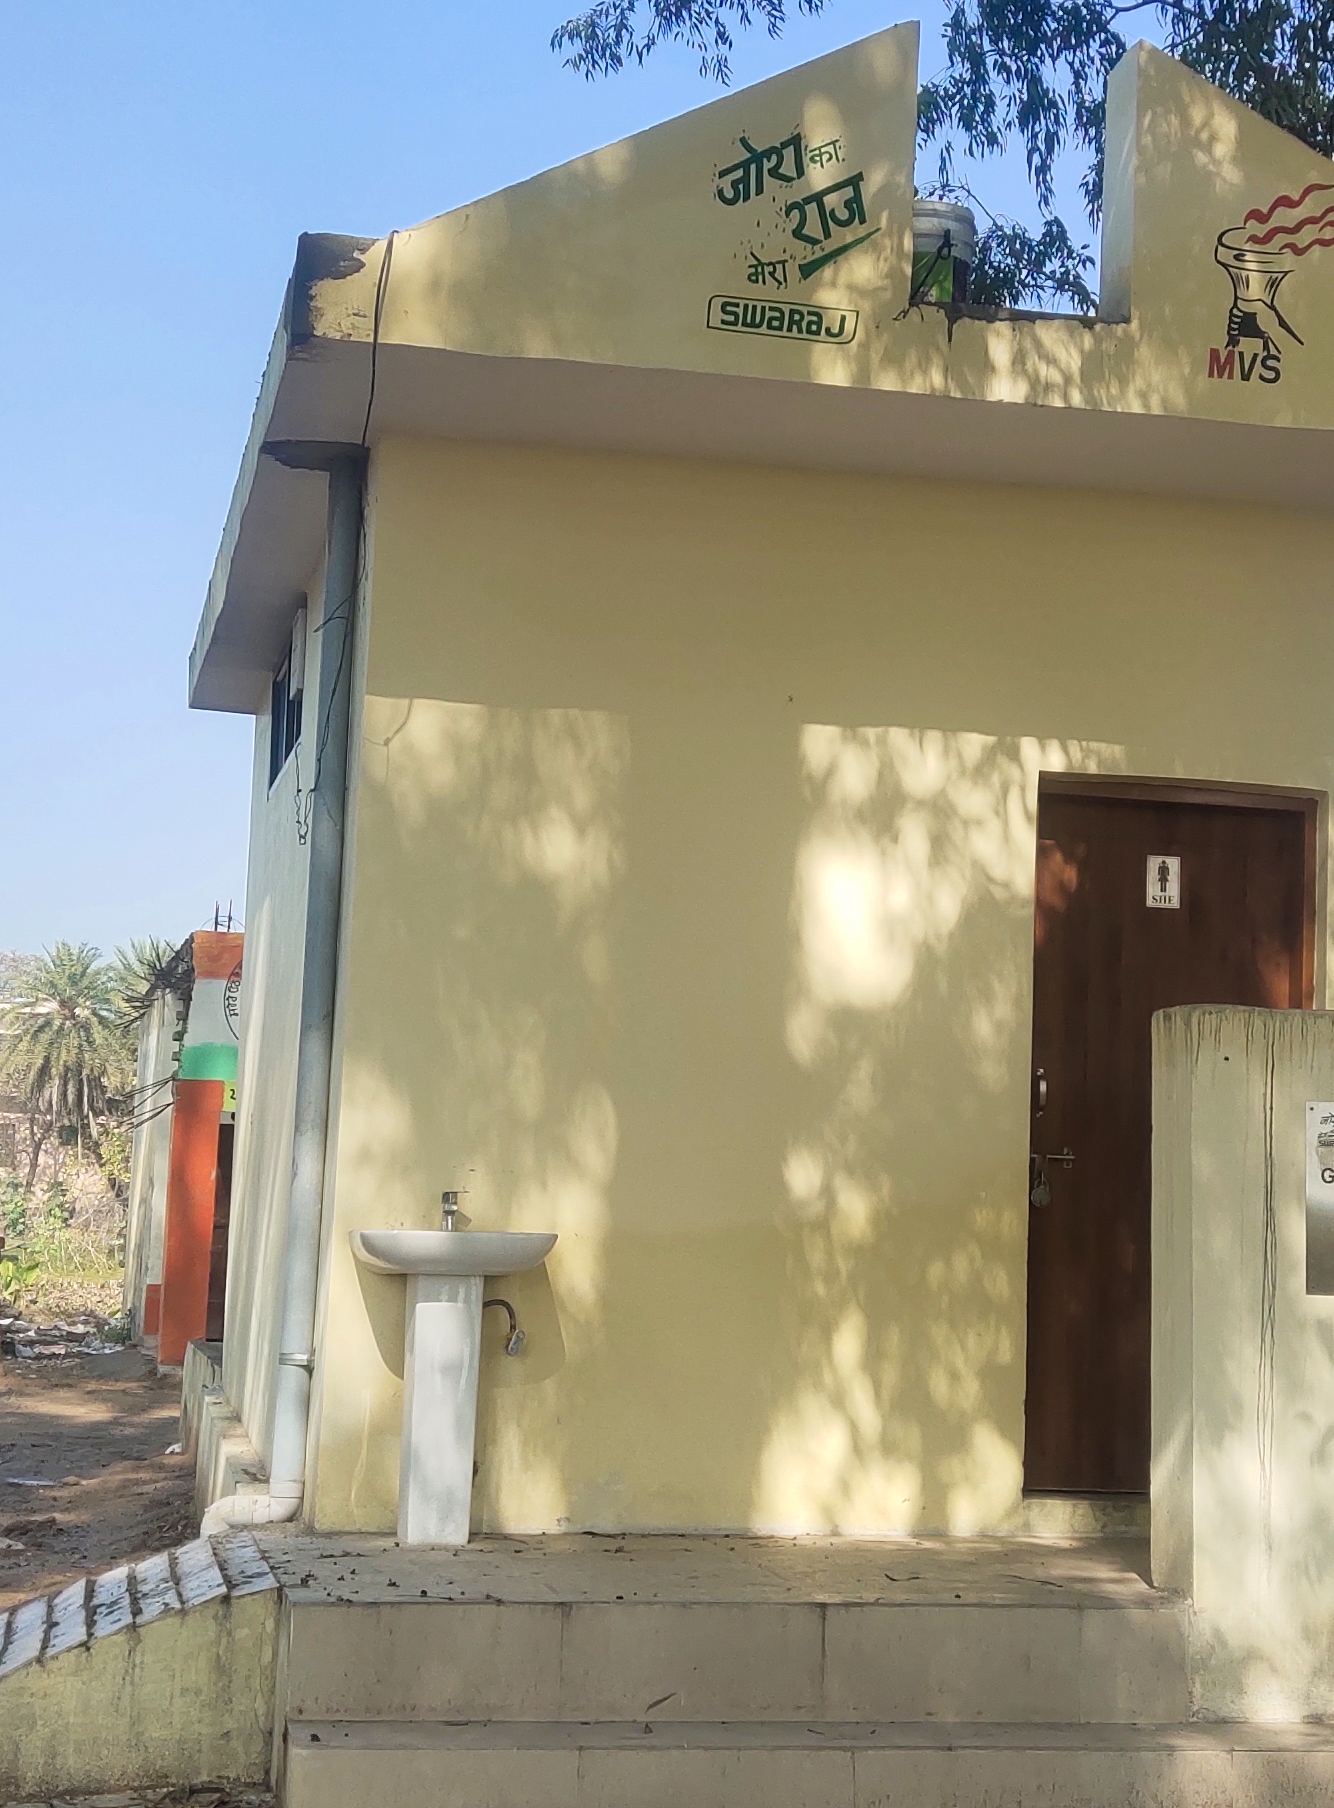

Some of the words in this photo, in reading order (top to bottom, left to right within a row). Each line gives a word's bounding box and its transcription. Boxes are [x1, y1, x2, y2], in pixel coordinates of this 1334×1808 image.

[808, 138, 841, 169] का
[784, 171, 868, 247] राज
[746, 251, 789, 287] मेरा
[1208, 347, 1282, 385] MVS
